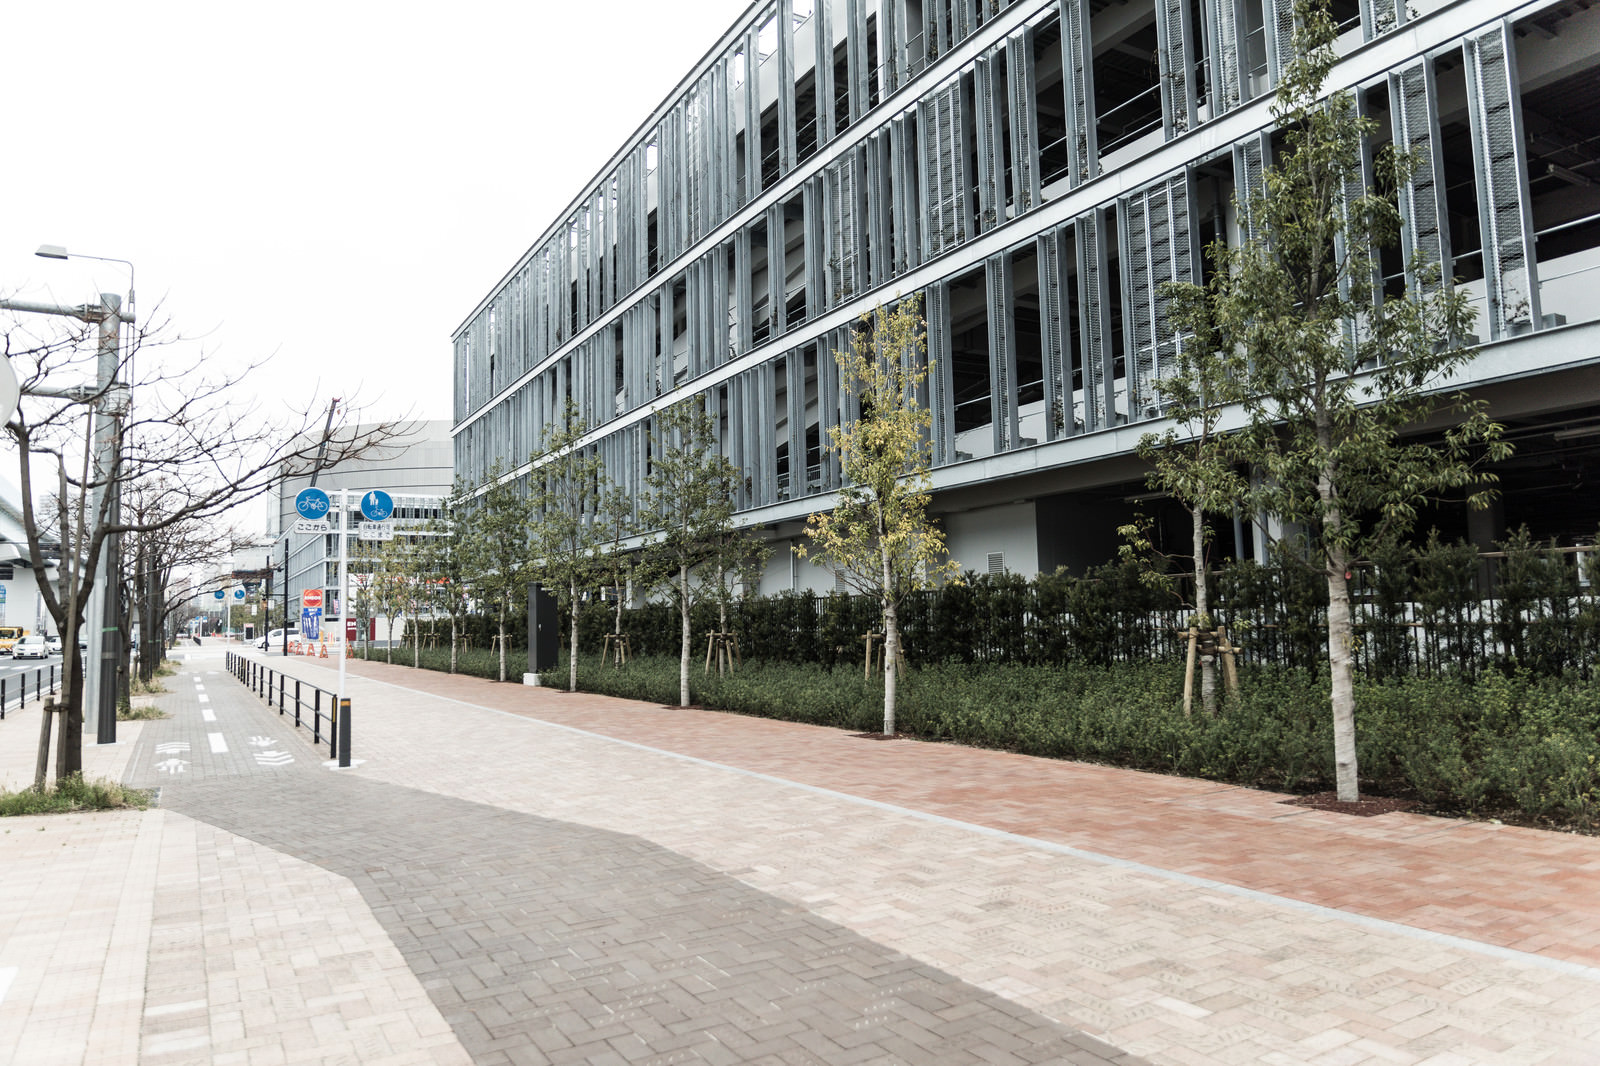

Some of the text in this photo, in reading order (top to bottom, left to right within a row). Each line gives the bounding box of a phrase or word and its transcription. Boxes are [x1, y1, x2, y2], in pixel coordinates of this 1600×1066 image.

[297, 523, 328, 532] ここから
[363, 531, 390, 539] ここまで
